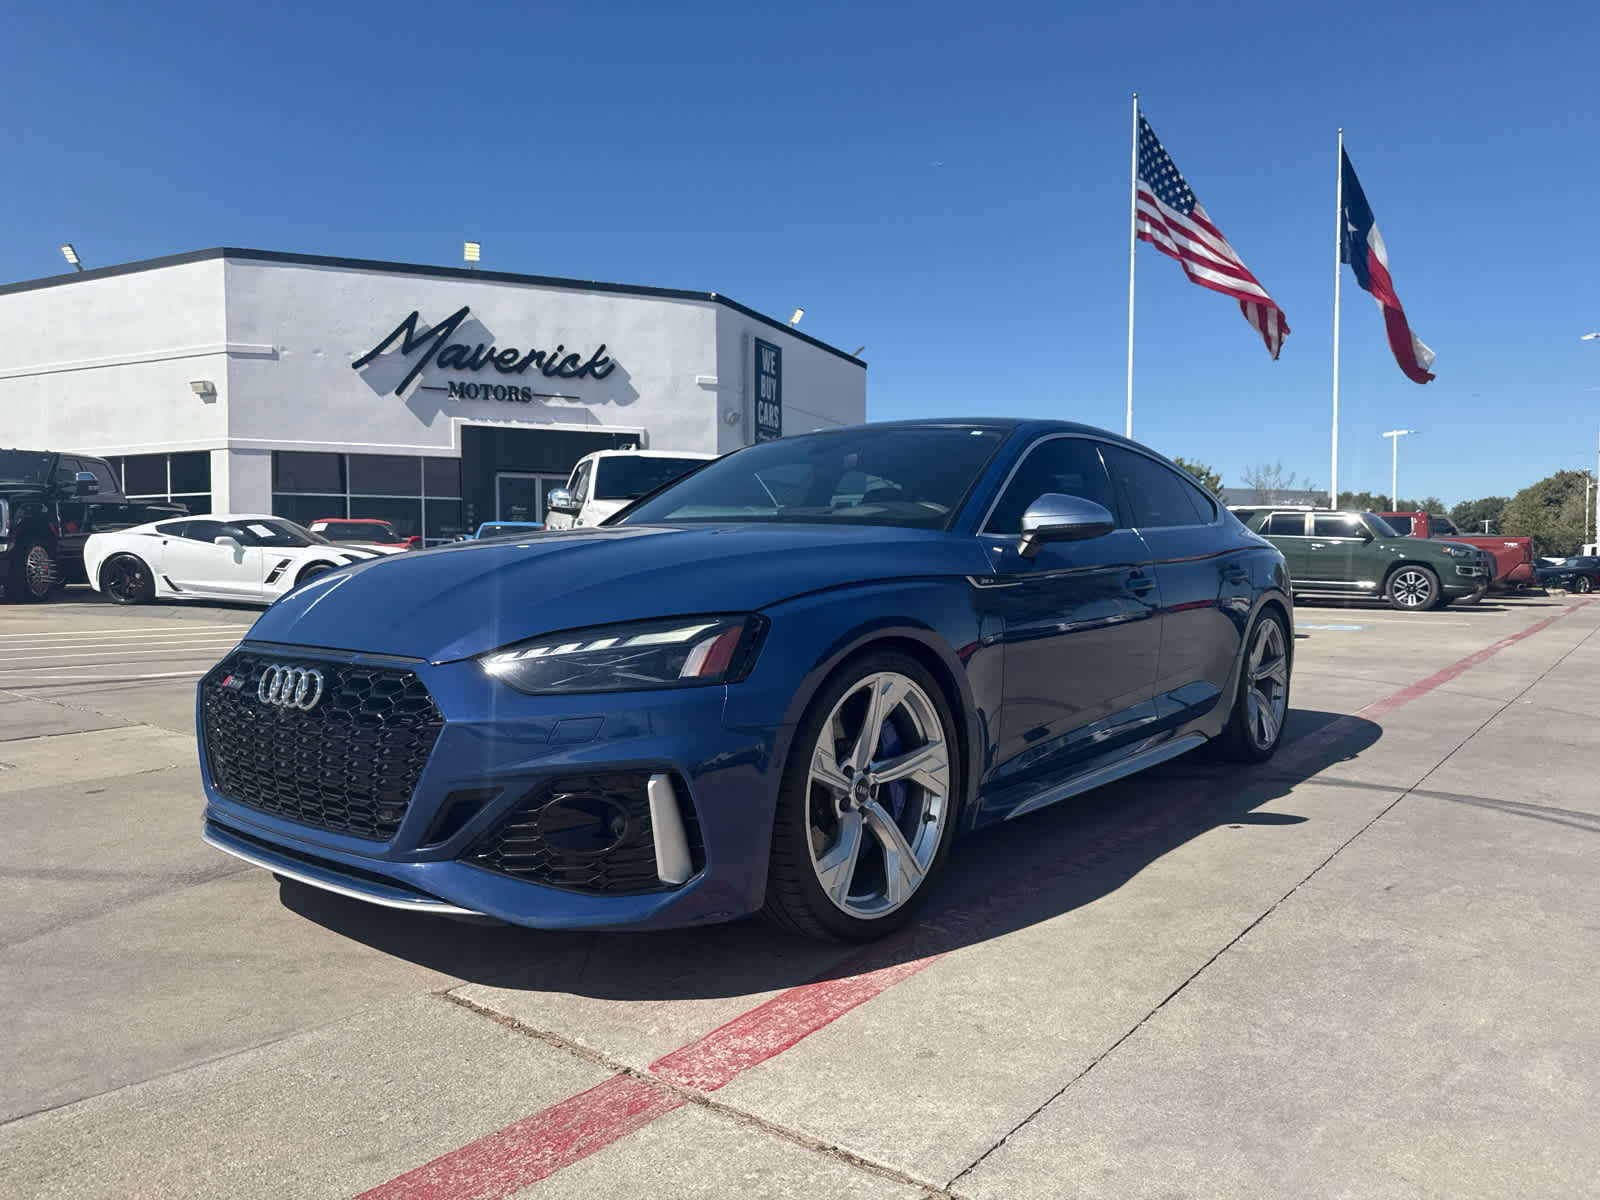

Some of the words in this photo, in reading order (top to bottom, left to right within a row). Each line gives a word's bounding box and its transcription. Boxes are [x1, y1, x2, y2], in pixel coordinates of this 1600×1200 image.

[351, 306, 616, 396] Maverick
[761, 347, 776, 375] WE
[447, 381, 533, 403] MOTORS
[760, 374, 777, 402] BUY
[758, 400, 780, 429] CARS
